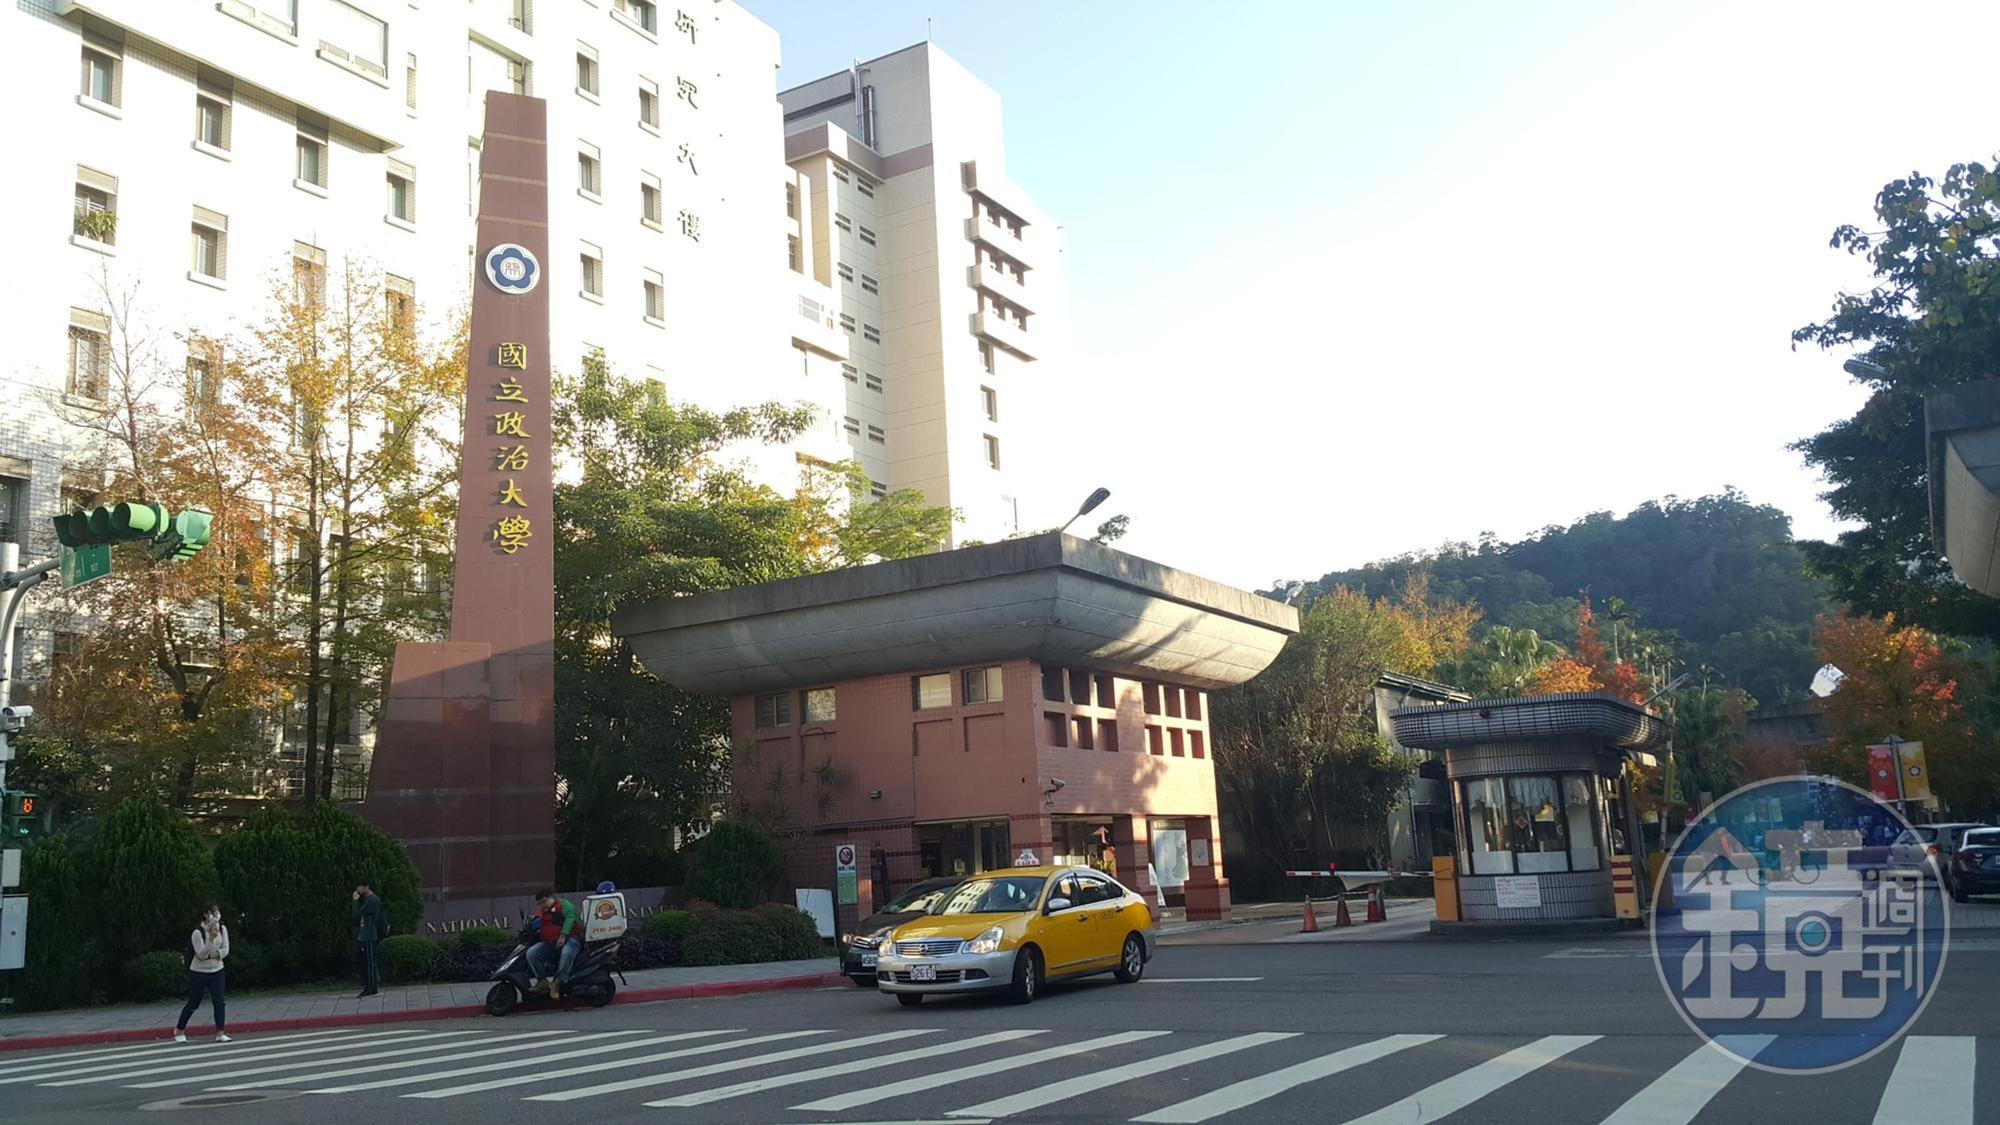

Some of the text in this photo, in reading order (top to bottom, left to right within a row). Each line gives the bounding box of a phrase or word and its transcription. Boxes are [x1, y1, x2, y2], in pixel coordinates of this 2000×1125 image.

[493, 342, 533, 555] 國立政治大學
[425, 916, 512, 934] NATIONAL
